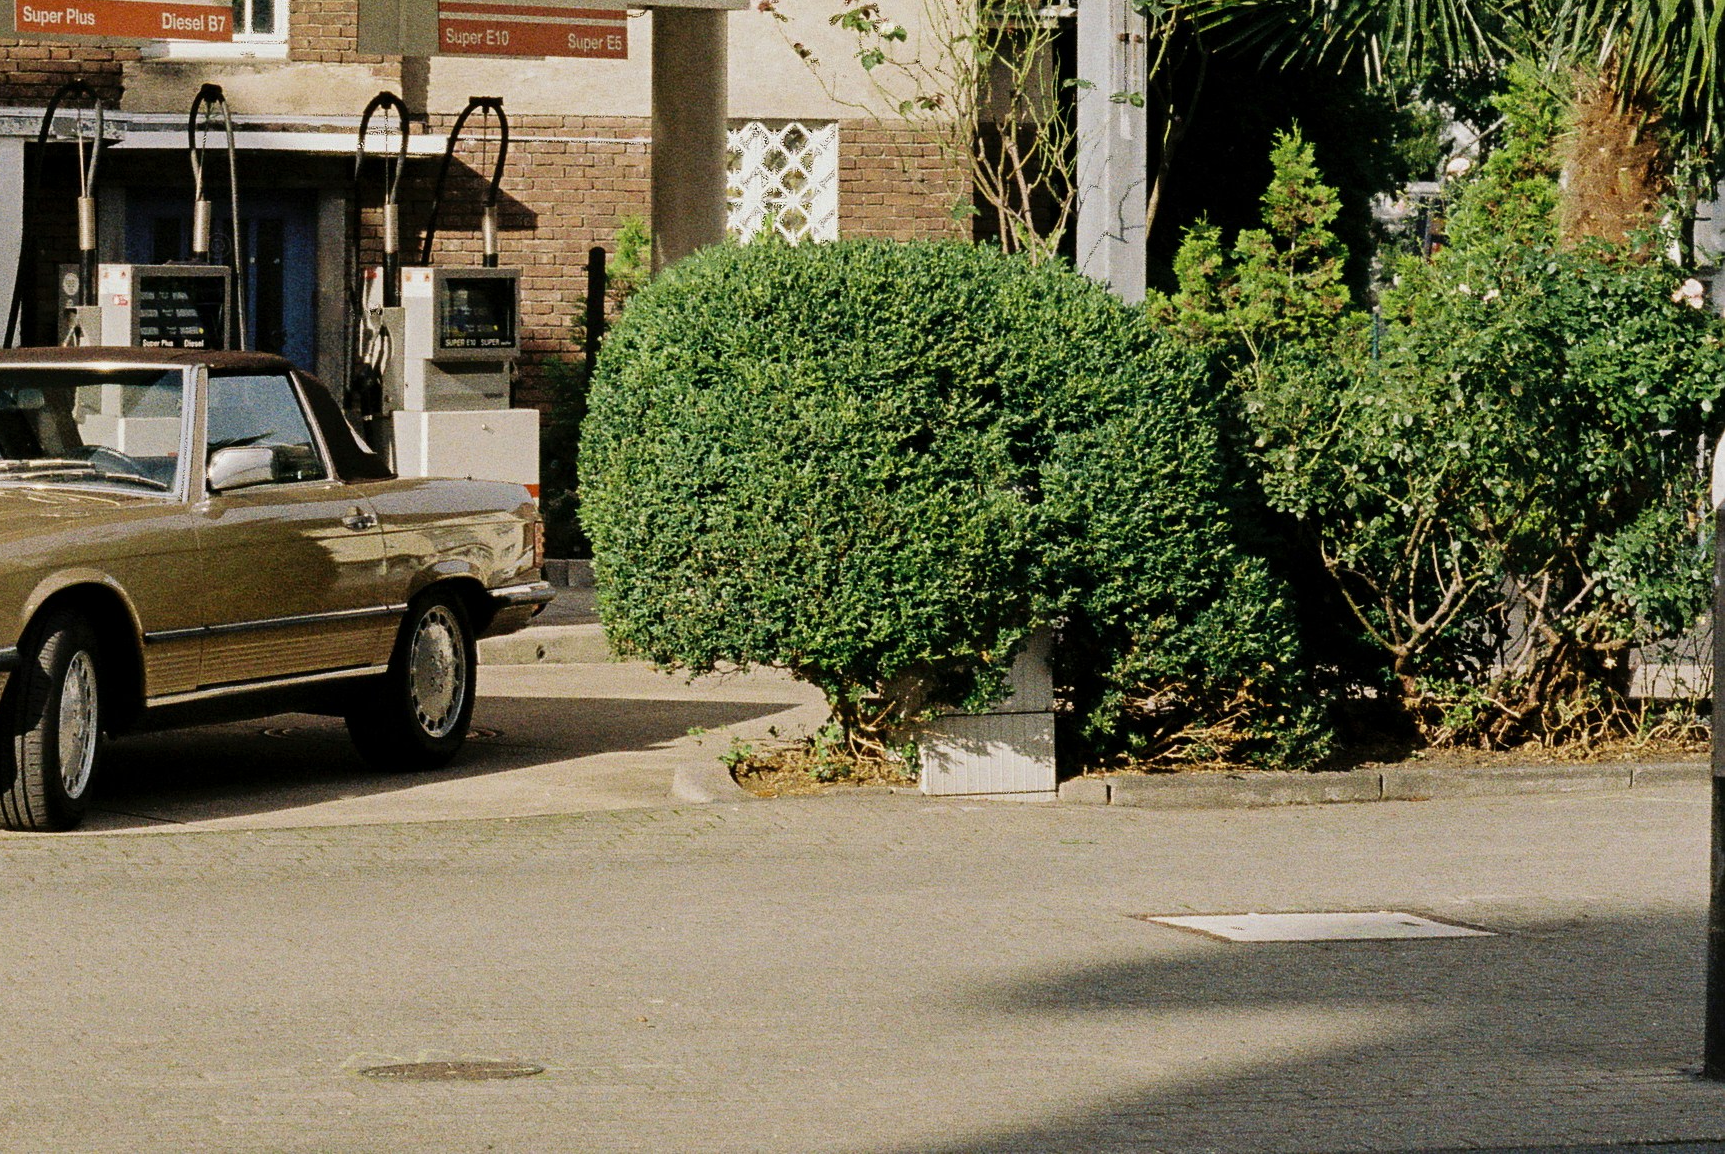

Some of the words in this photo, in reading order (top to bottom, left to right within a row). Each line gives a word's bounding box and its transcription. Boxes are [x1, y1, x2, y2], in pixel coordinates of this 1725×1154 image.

[23, 6, 63, 27] Super
[66, 7, 95, 26] Plus
[162, 12, 204, 31] Diesel
[208, 14, 225, 32] B7
[445, 27, 482, 46] Super
[486, 29, 509, 46] E10
[568, 33, 603, 51] Super
[607, 35, 622, 51] E5
[445, 338, 465, 346] SUPER
[480, 338, 500, 346] SUPER
